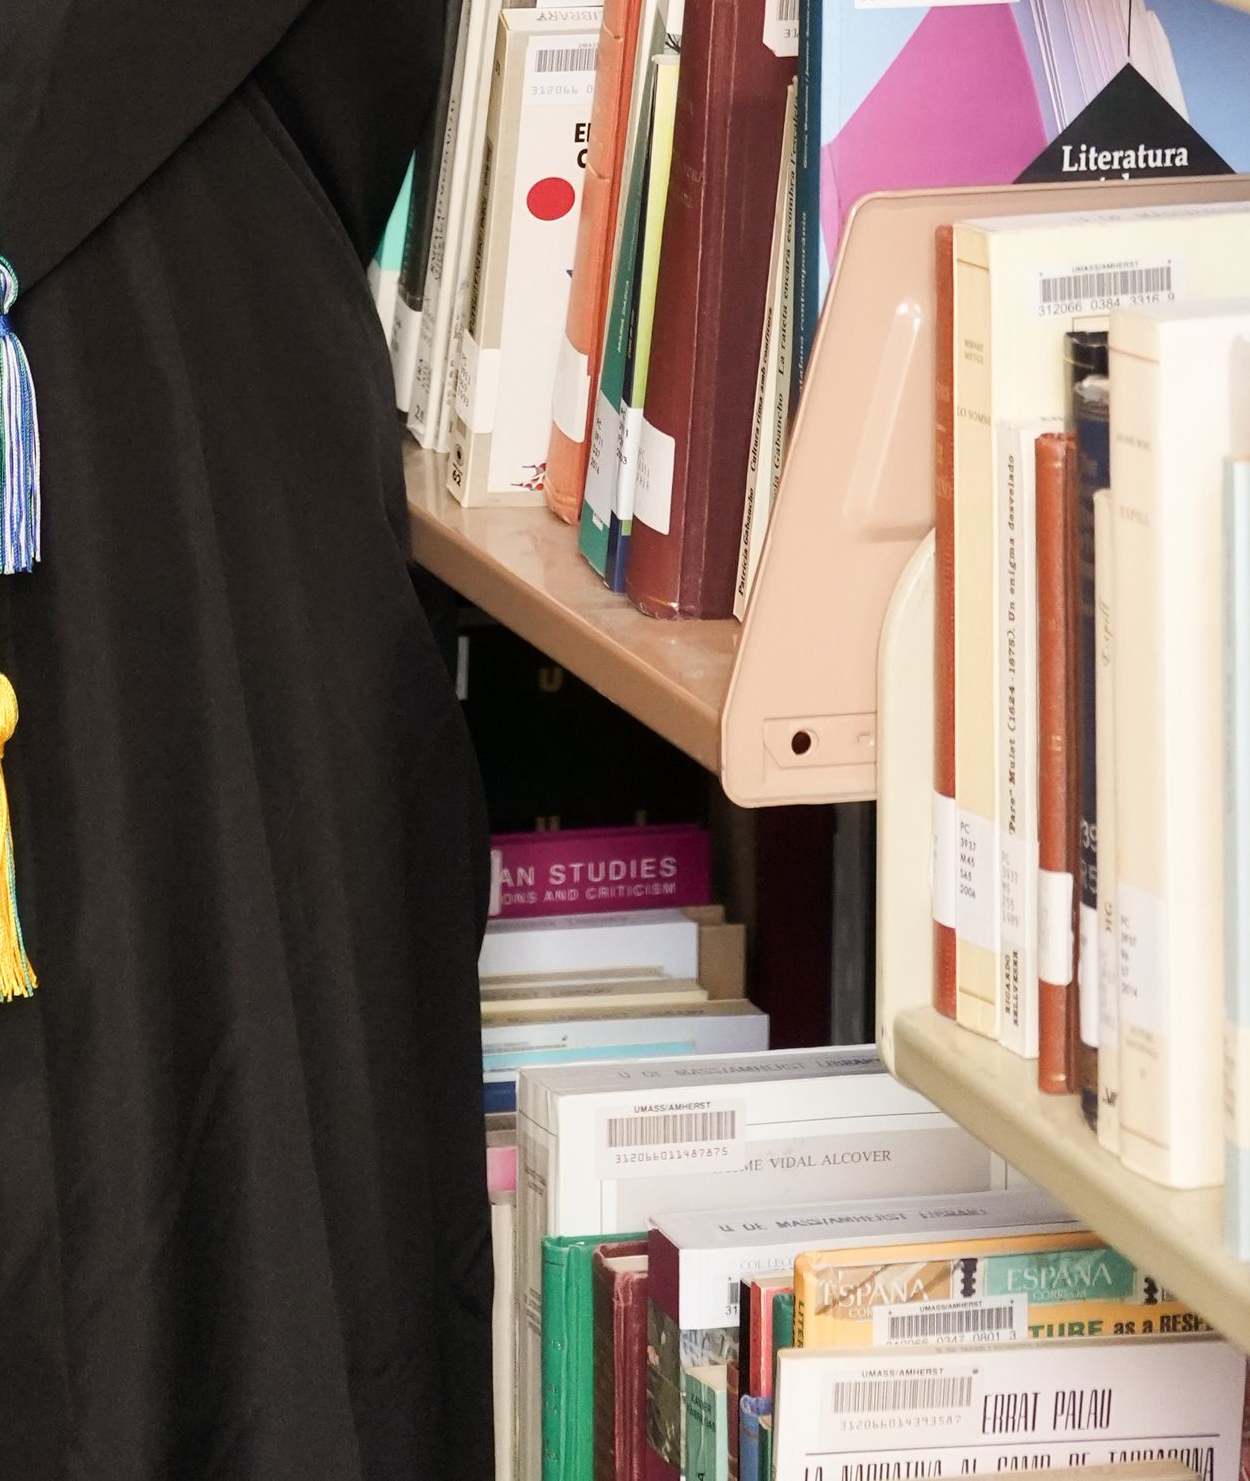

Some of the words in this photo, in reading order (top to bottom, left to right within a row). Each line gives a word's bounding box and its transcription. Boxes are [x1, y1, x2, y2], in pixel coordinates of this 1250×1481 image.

[531, 86, 578, 96] 312066
[1061, 142, 1189, 173] Literatura
[783, 246, 792, 299] encara
[1071, 261, 1140, 273] UMASS/AMHERST
[1038, 300, 1082, 317] 312066
[1090, 297, 1122, 310] 0384
[762, 306, 775, 367] confitura
[780, 304, 790, 352] rateta
[777, 353, 786, 376] La
[759, 369, 768, 397] amb
[774, 393, 785, 470] Gabancho
[750, 425, 762, 473] Cultura
[1006, 454, 1016, 531] desvelado
[743, 487, 755, 542] Gabancho
[1007, 537, 1017, 595] enigma
[959, 823, 970, 836] PC
[959, 837, 977, 852] 3937
[549, 855, 679, 885] STUDIES
[959, 854, 976, 868] M45
[543, 887, 579, 903] AND
[585, 881, 677, 901] CRITICISM
[959, 884, 977, 899] 2006
[1004, 953, 1012, 1016] RICARDO
[674, 1060, 808, 1077] MASS/AMHERST
[633, 1101, 712, 1113] UMASS/AMHERST
[614, 1146, 729, 1165] 312066011487875
[769, 1154, 817, 1170] VIDAL
[821, 1149, 892, 1167] ALCOVER
[742, 1221, 764, 1232] OF
[775, 1211, 907, 1229] MASS/AMHERST
[919, 1300, 983, 1312] UMASS/AMHERST
[1113, 1320, 1136, 1335] as
[1142, 1320, 1153, 1333] a
[861, 1368, 945, 1379] UMASS/AMHERST
[1053, 1388, 1113, 1433] PALAU
